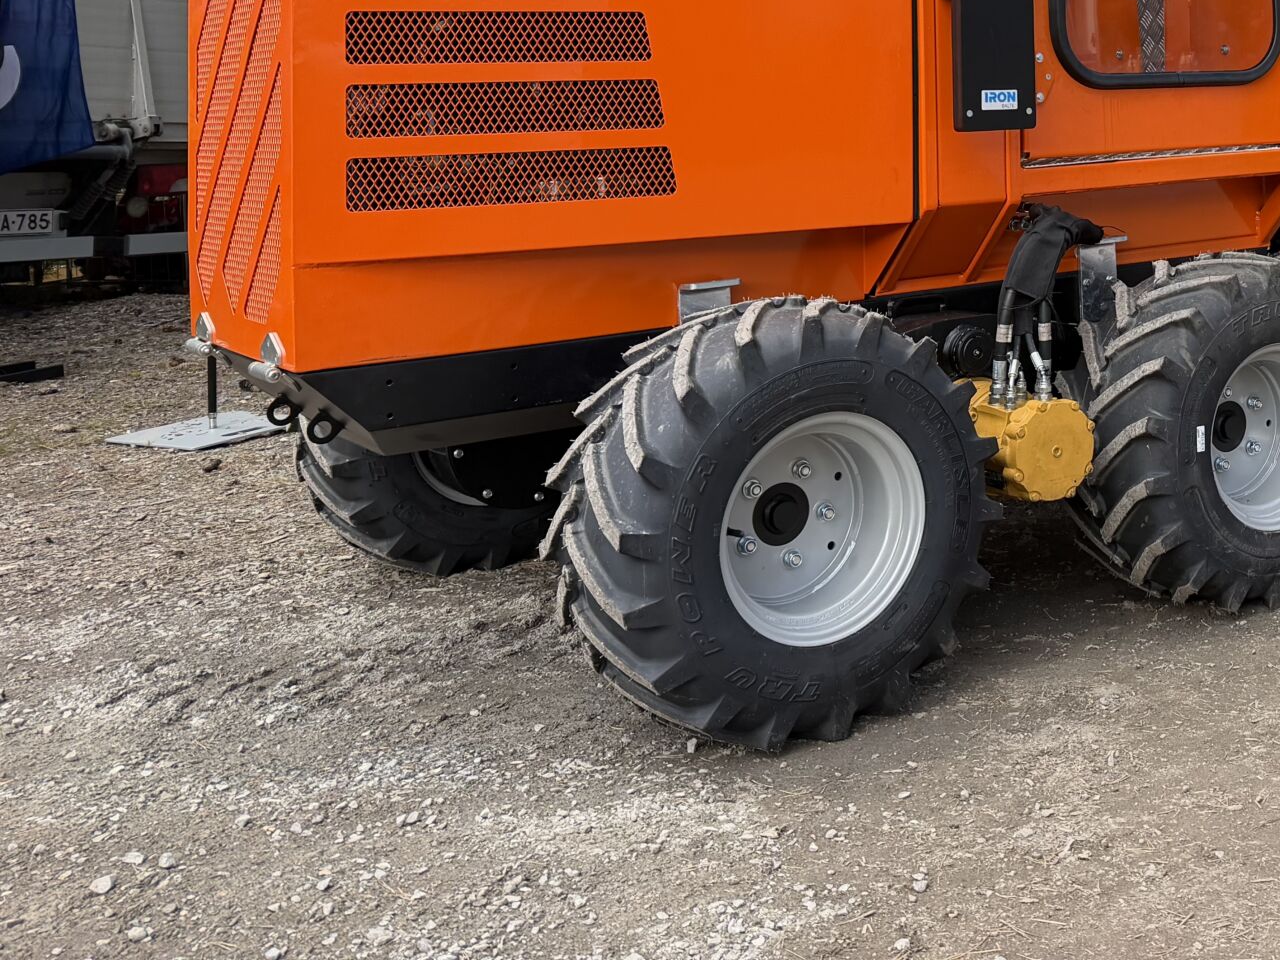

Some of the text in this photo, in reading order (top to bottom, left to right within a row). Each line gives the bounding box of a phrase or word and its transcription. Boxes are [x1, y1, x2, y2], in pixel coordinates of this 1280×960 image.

[984, 91, 1016, 103] IRON
[671, 452, 824, 703] TRU POWER
